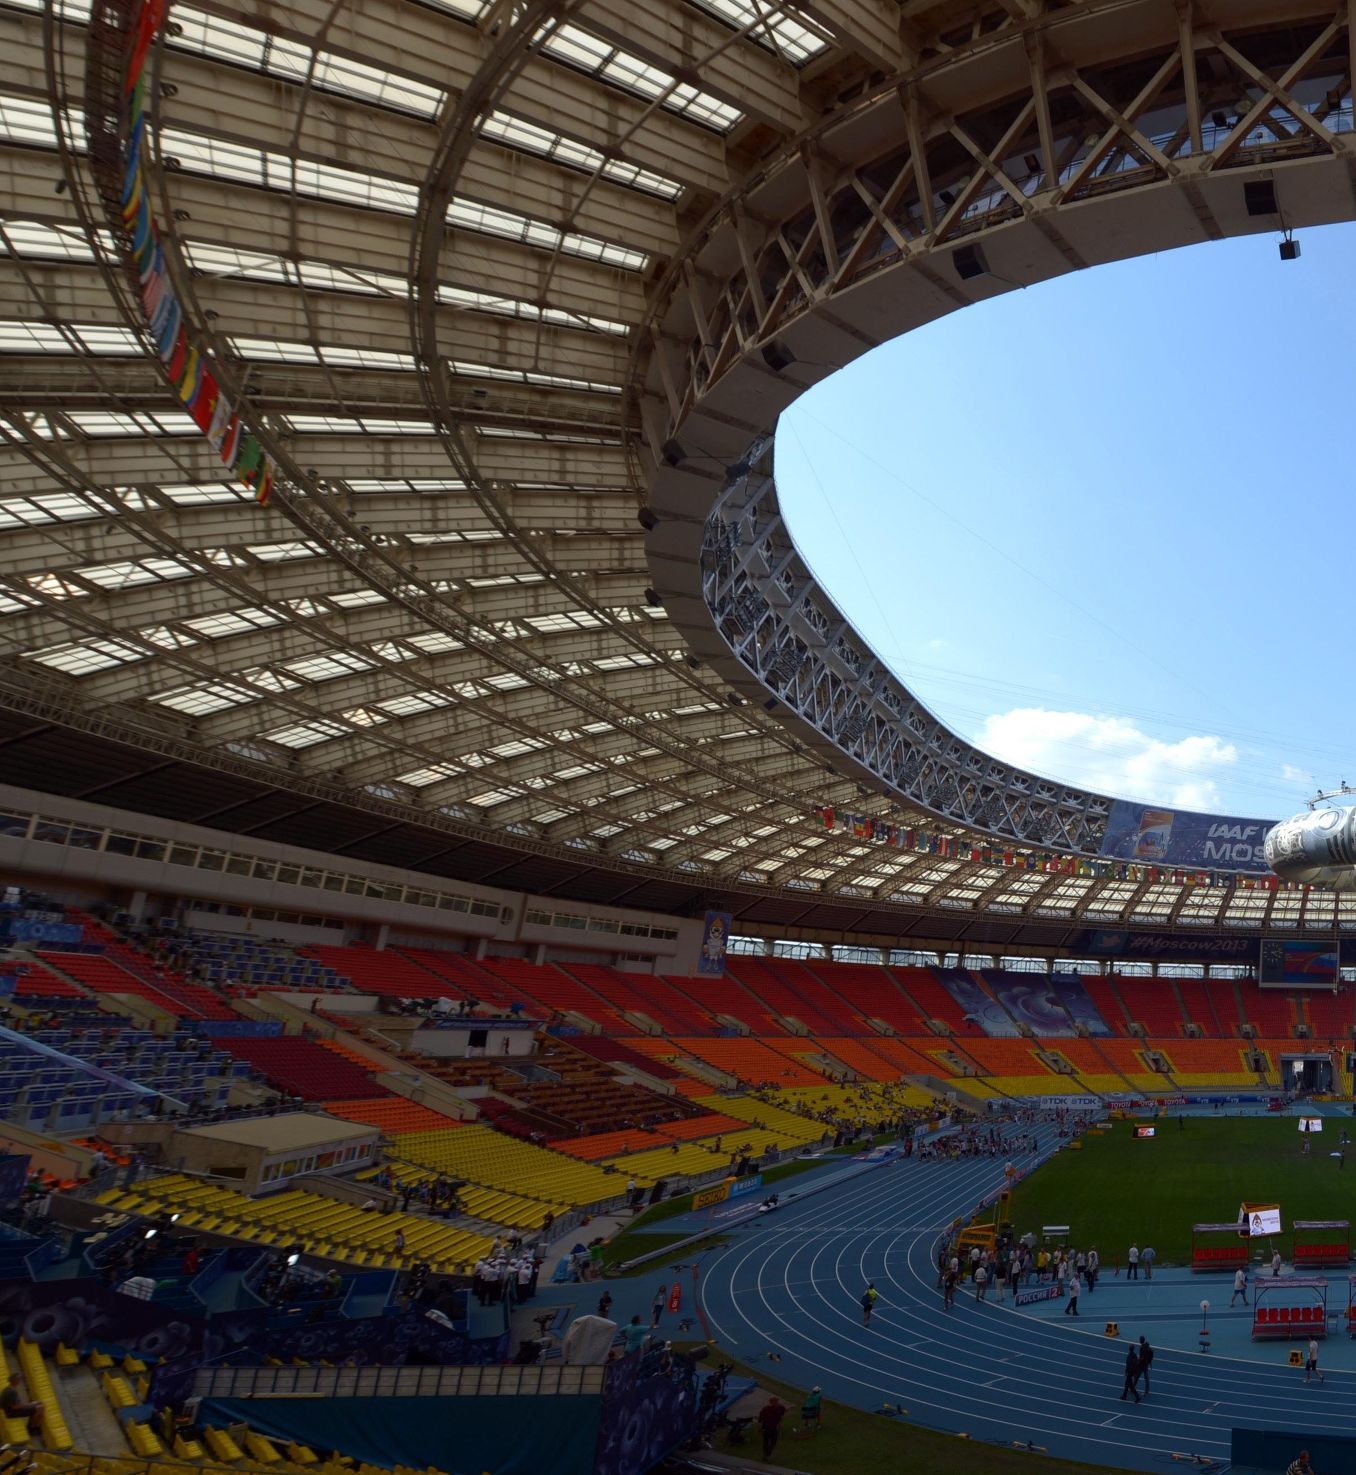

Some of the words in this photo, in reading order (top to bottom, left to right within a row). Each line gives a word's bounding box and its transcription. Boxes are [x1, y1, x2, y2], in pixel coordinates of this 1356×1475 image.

[1207, 823, 1259, 840] IAAF
[1203, 841, 1266, 863] MOS
[1130, 936, 1248, 951] #Moscow2013
